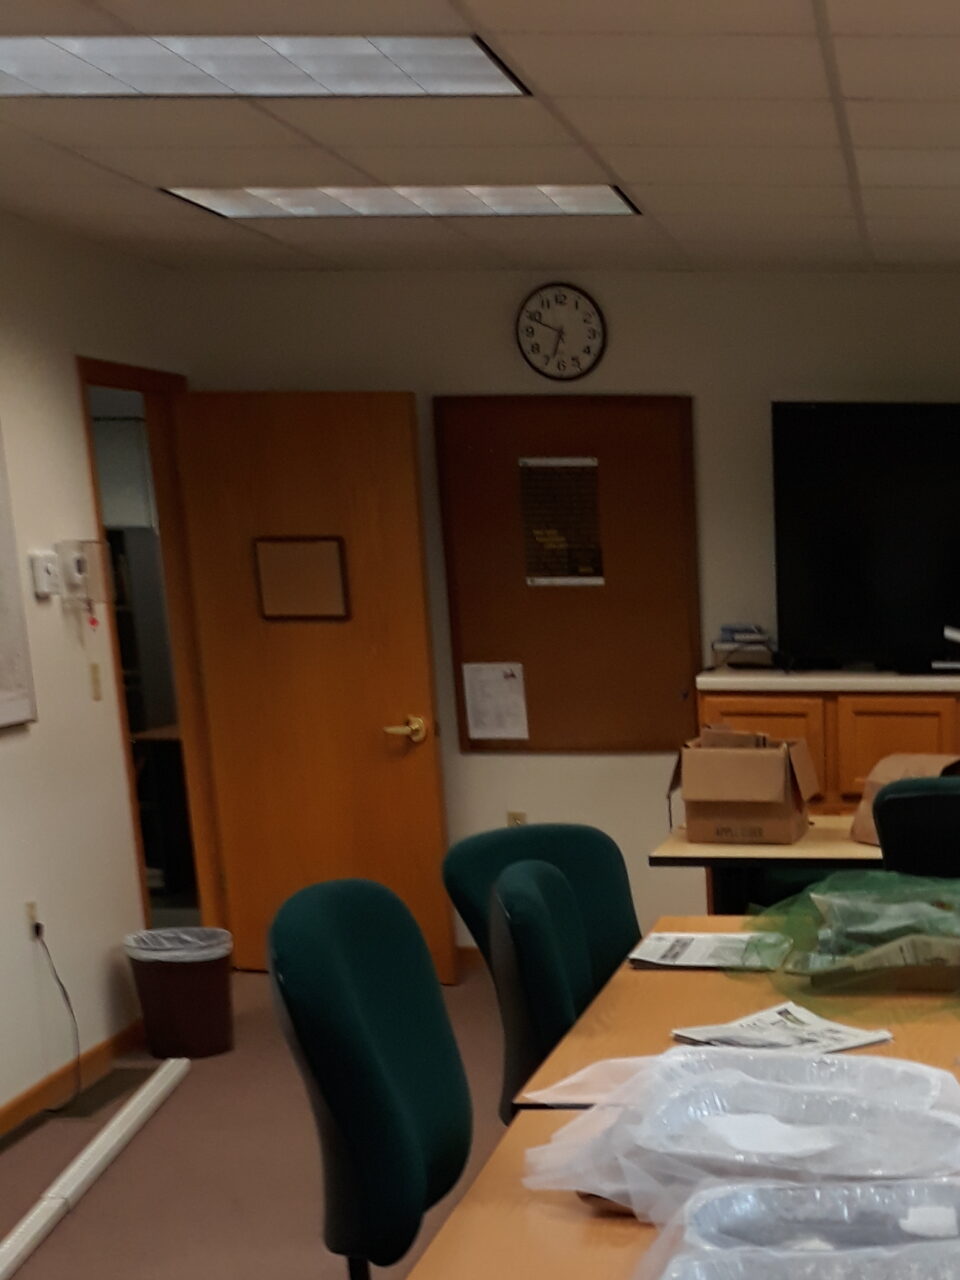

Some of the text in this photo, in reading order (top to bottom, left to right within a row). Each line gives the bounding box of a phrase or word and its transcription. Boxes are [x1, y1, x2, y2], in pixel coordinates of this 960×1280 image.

[541, 298, 550, 310] 11
[554, 293, 567, 305] 12
[583, 312, 592, 324] 2
[525, 326, 534, 337] 9
[588, 328, 597, 339] 3
[531, 343, 540, 354] 8
[583, 345, 591, 354] 4
[543, 354, 550, 366] 7
[557, 360, 567, 371] 6
